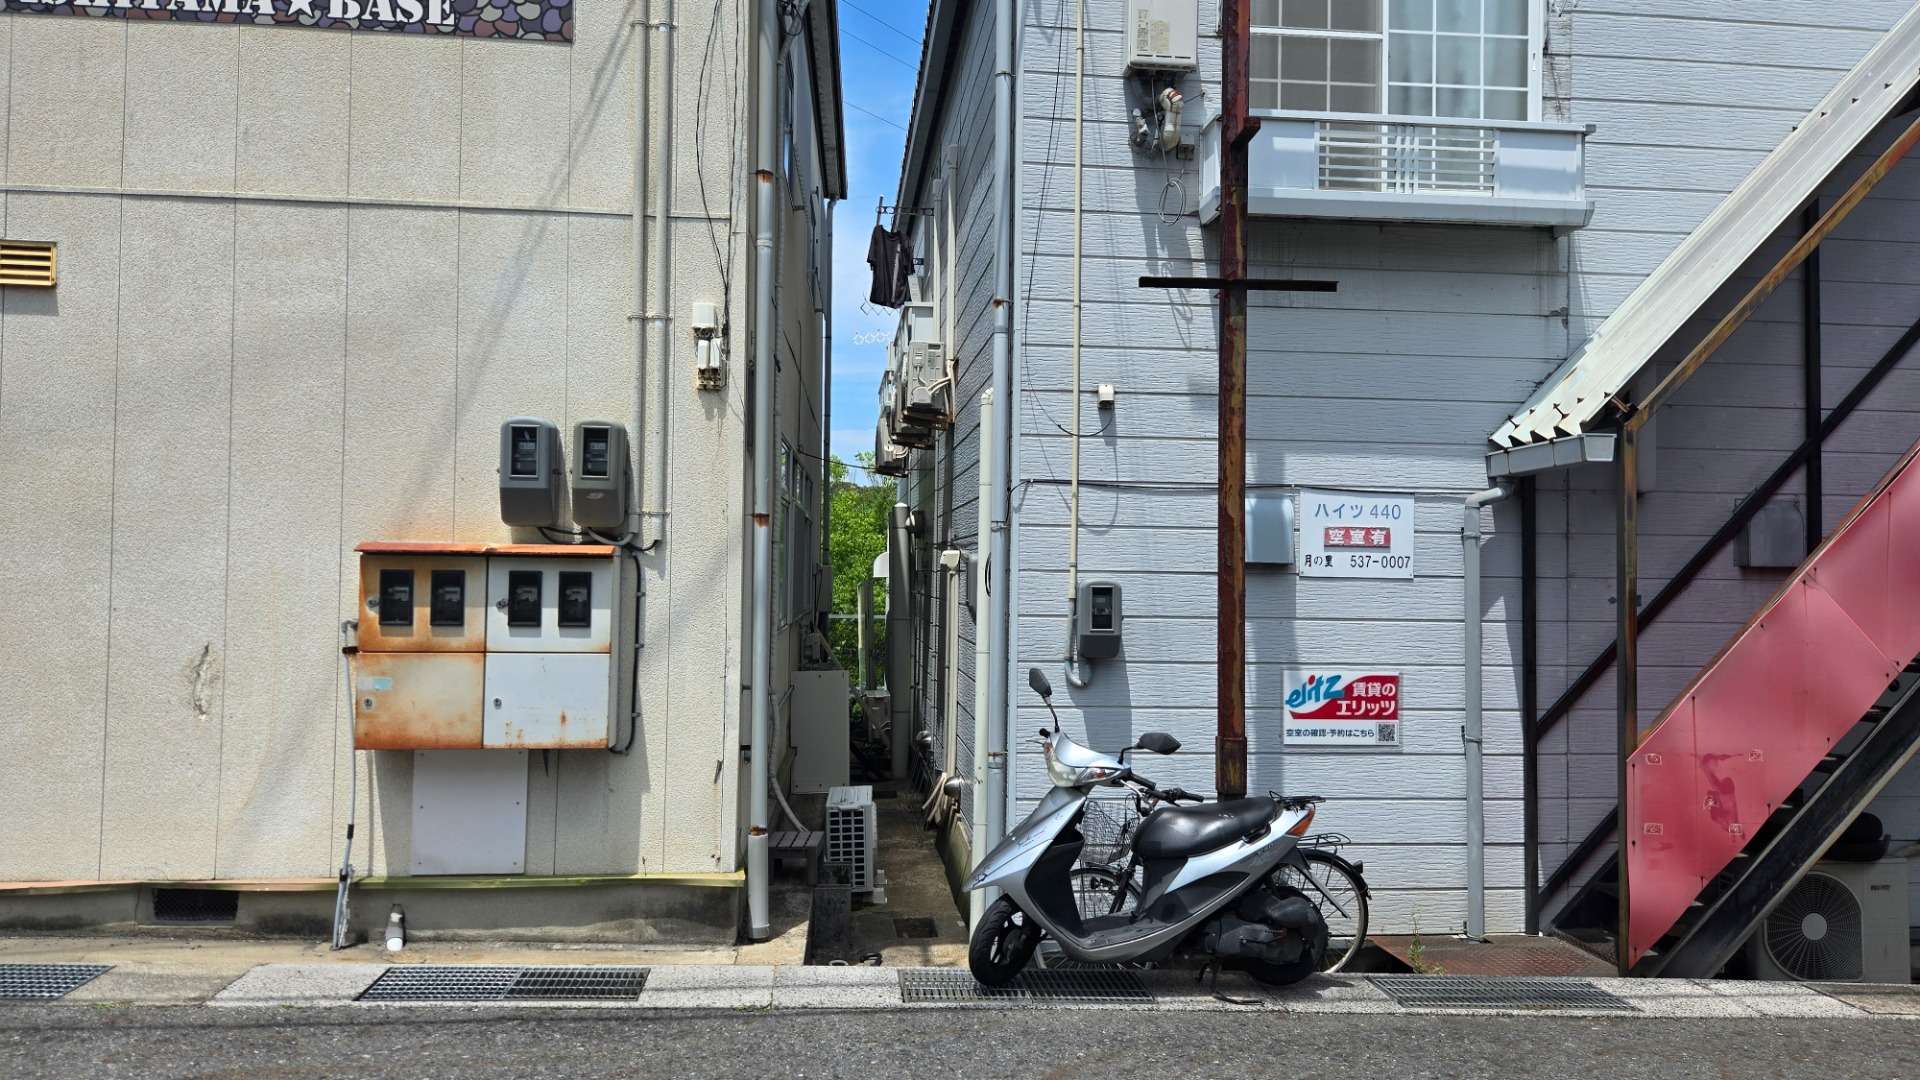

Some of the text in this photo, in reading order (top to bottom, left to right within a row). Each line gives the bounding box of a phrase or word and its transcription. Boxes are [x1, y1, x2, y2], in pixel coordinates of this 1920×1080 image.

[327, 0, 455, 25] BASE
[1315, 503, 1402, 520] ハイツ 440
[1328, 528, 1387, 545] 空室有
[1350, 555, 1411, 569] 537-0007
[1285, 674, 1345, 709] elitz
[1352, 682, 1396, 698] 賃貸の
[1335, 700, 1396, 716] エリッツ
